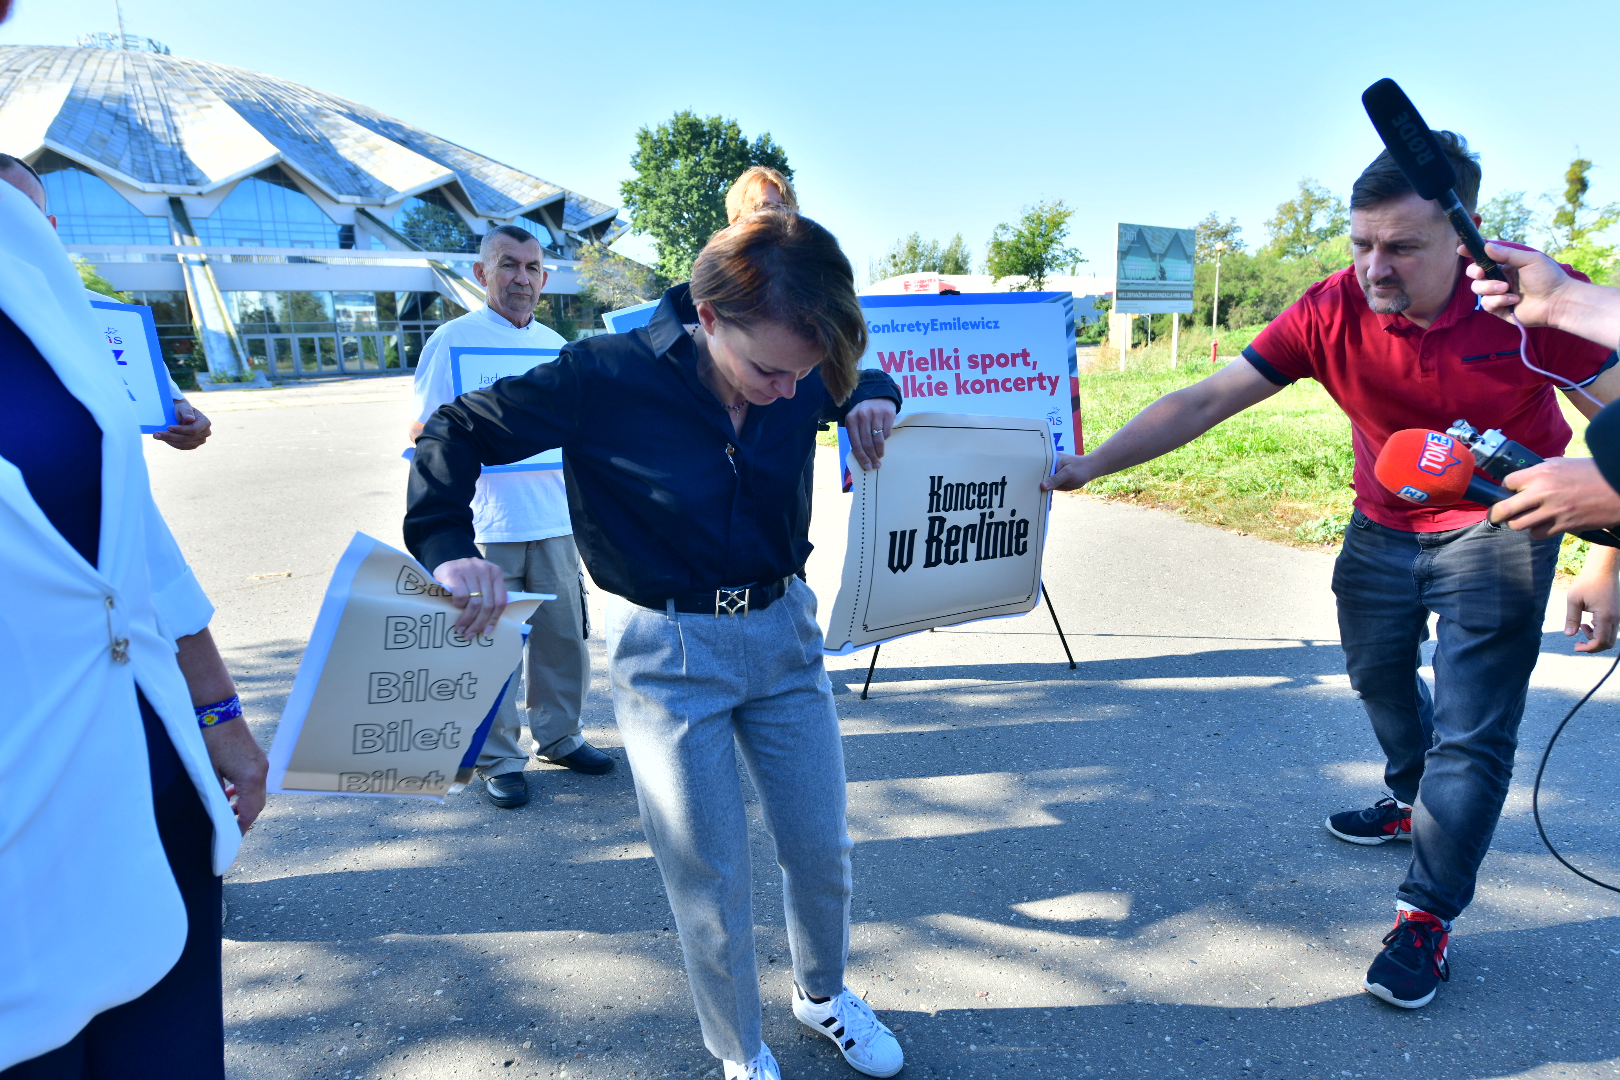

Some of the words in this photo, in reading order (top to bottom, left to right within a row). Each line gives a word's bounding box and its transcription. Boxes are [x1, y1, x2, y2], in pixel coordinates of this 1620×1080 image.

[1391, 111, 1436, 166] RØDE
[877, 347, 961, 374] Wielki
[967, 348, 1038, 375] sport,
[897, 374, 949, 398] lkie
[955, 372, 1061, 397] koncerty
[1420, 440, 1449, 470] TOK
[1430, 433, 1449, 446] FM
[926, 475, 1008, 514] Koncert
[923, 508, 1030, 569] Berlinie
[367, 668, 478, 705] Bilet
[352, 719, 462, 755] Bilet
[338, 767, 446, 793] Bilet
